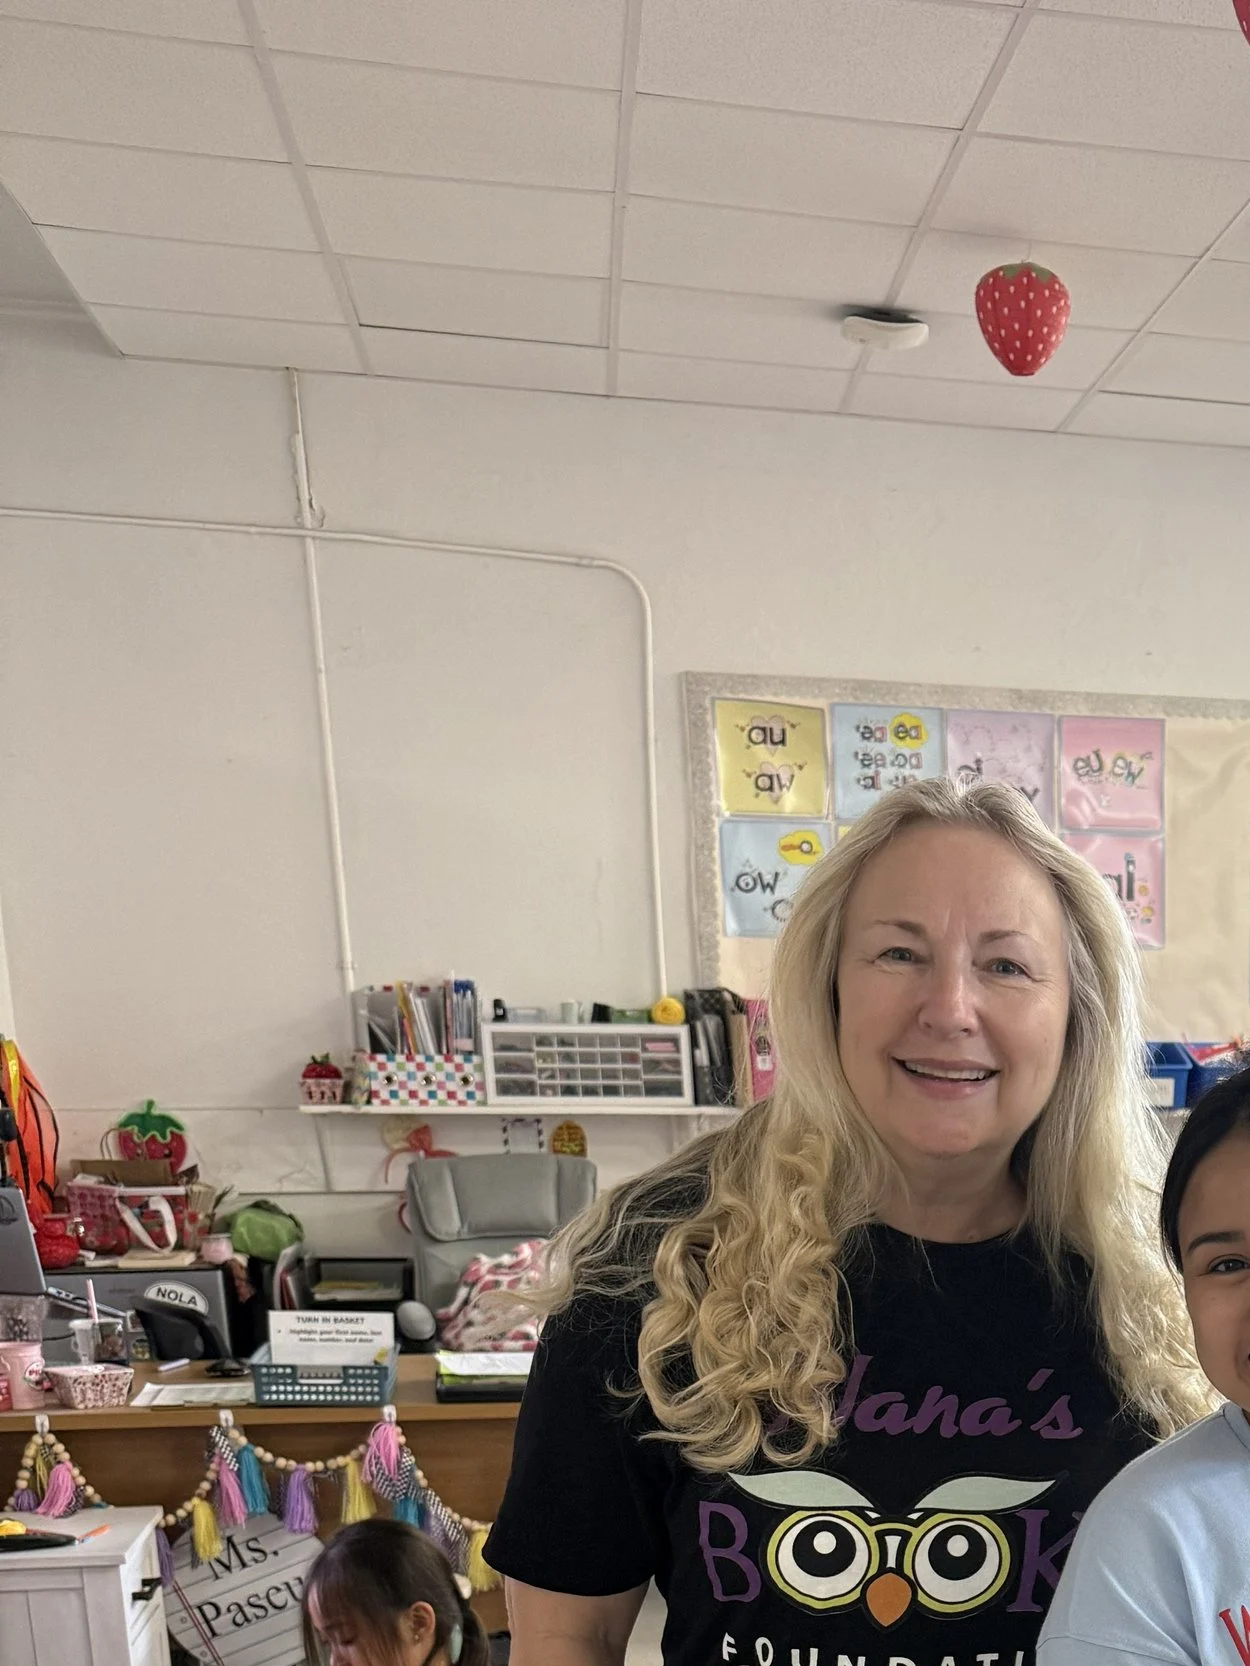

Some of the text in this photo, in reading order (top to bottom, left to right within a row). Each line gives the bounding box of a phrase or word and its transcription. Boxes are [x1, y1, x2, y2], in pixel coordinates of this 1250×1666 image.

[748, 725, 786, 747] au
[755, 772, 795, 793] aw
[735, 871, 780, 895] ow
[156, 1287, 198, 1307] NOLA
[296, 1316, 365, 1325] TURN IN BASKET
[836, 1355, 1084, 1440] ana's
[207, 1534, 280, 1581] Ms.
[194, 1576, 304, 1637] Pascu
